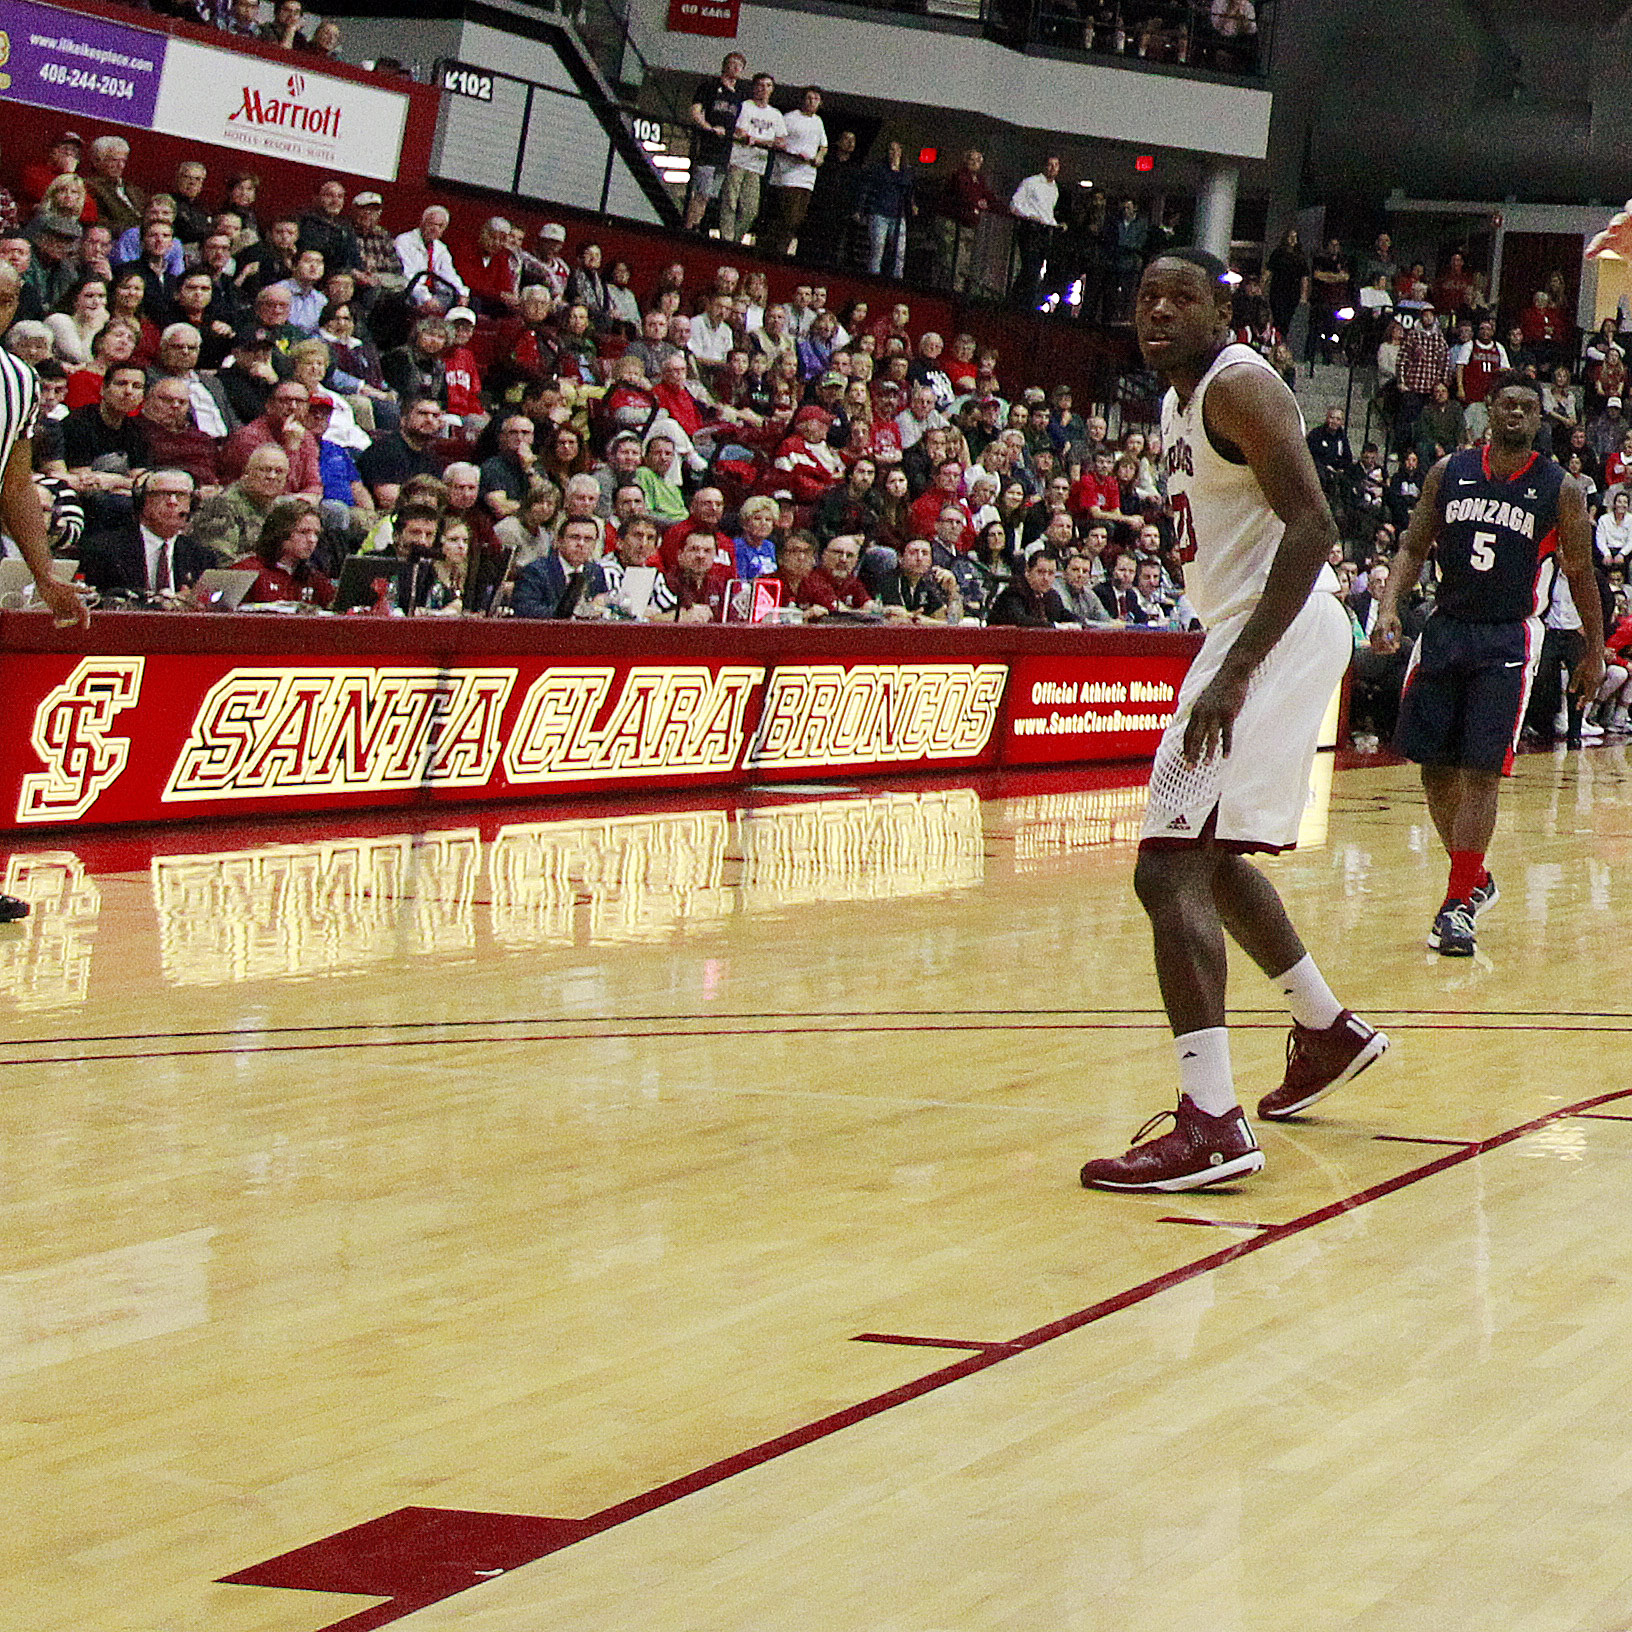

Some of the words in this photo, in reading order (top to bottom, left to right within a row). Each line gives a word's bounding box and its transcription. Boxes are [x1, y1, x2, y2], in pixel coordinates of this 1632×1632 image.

[38, 62, 136, 100] 408-244-2034
[457, 72, 492, 100] 102
[227, 85, 342, 139] Marriott
[633, 118, 662, 142] 103
[1445, 497, 1536, 540] GONZAGA
[1469, 529, 1497, 572] 5
[1031, 680, 1078, 705] Official
[1079, 680, 1127, 704] Athletic
[1129, 679, 1175, 703] Website
[160, 666, 519, 803] SANTA
[502, 665, 767, 784] CLARA
[740, 664, 1010, 770] BRONCOS
[1013, 709, 1176, 736] www.SantaClaraBroncos.co
